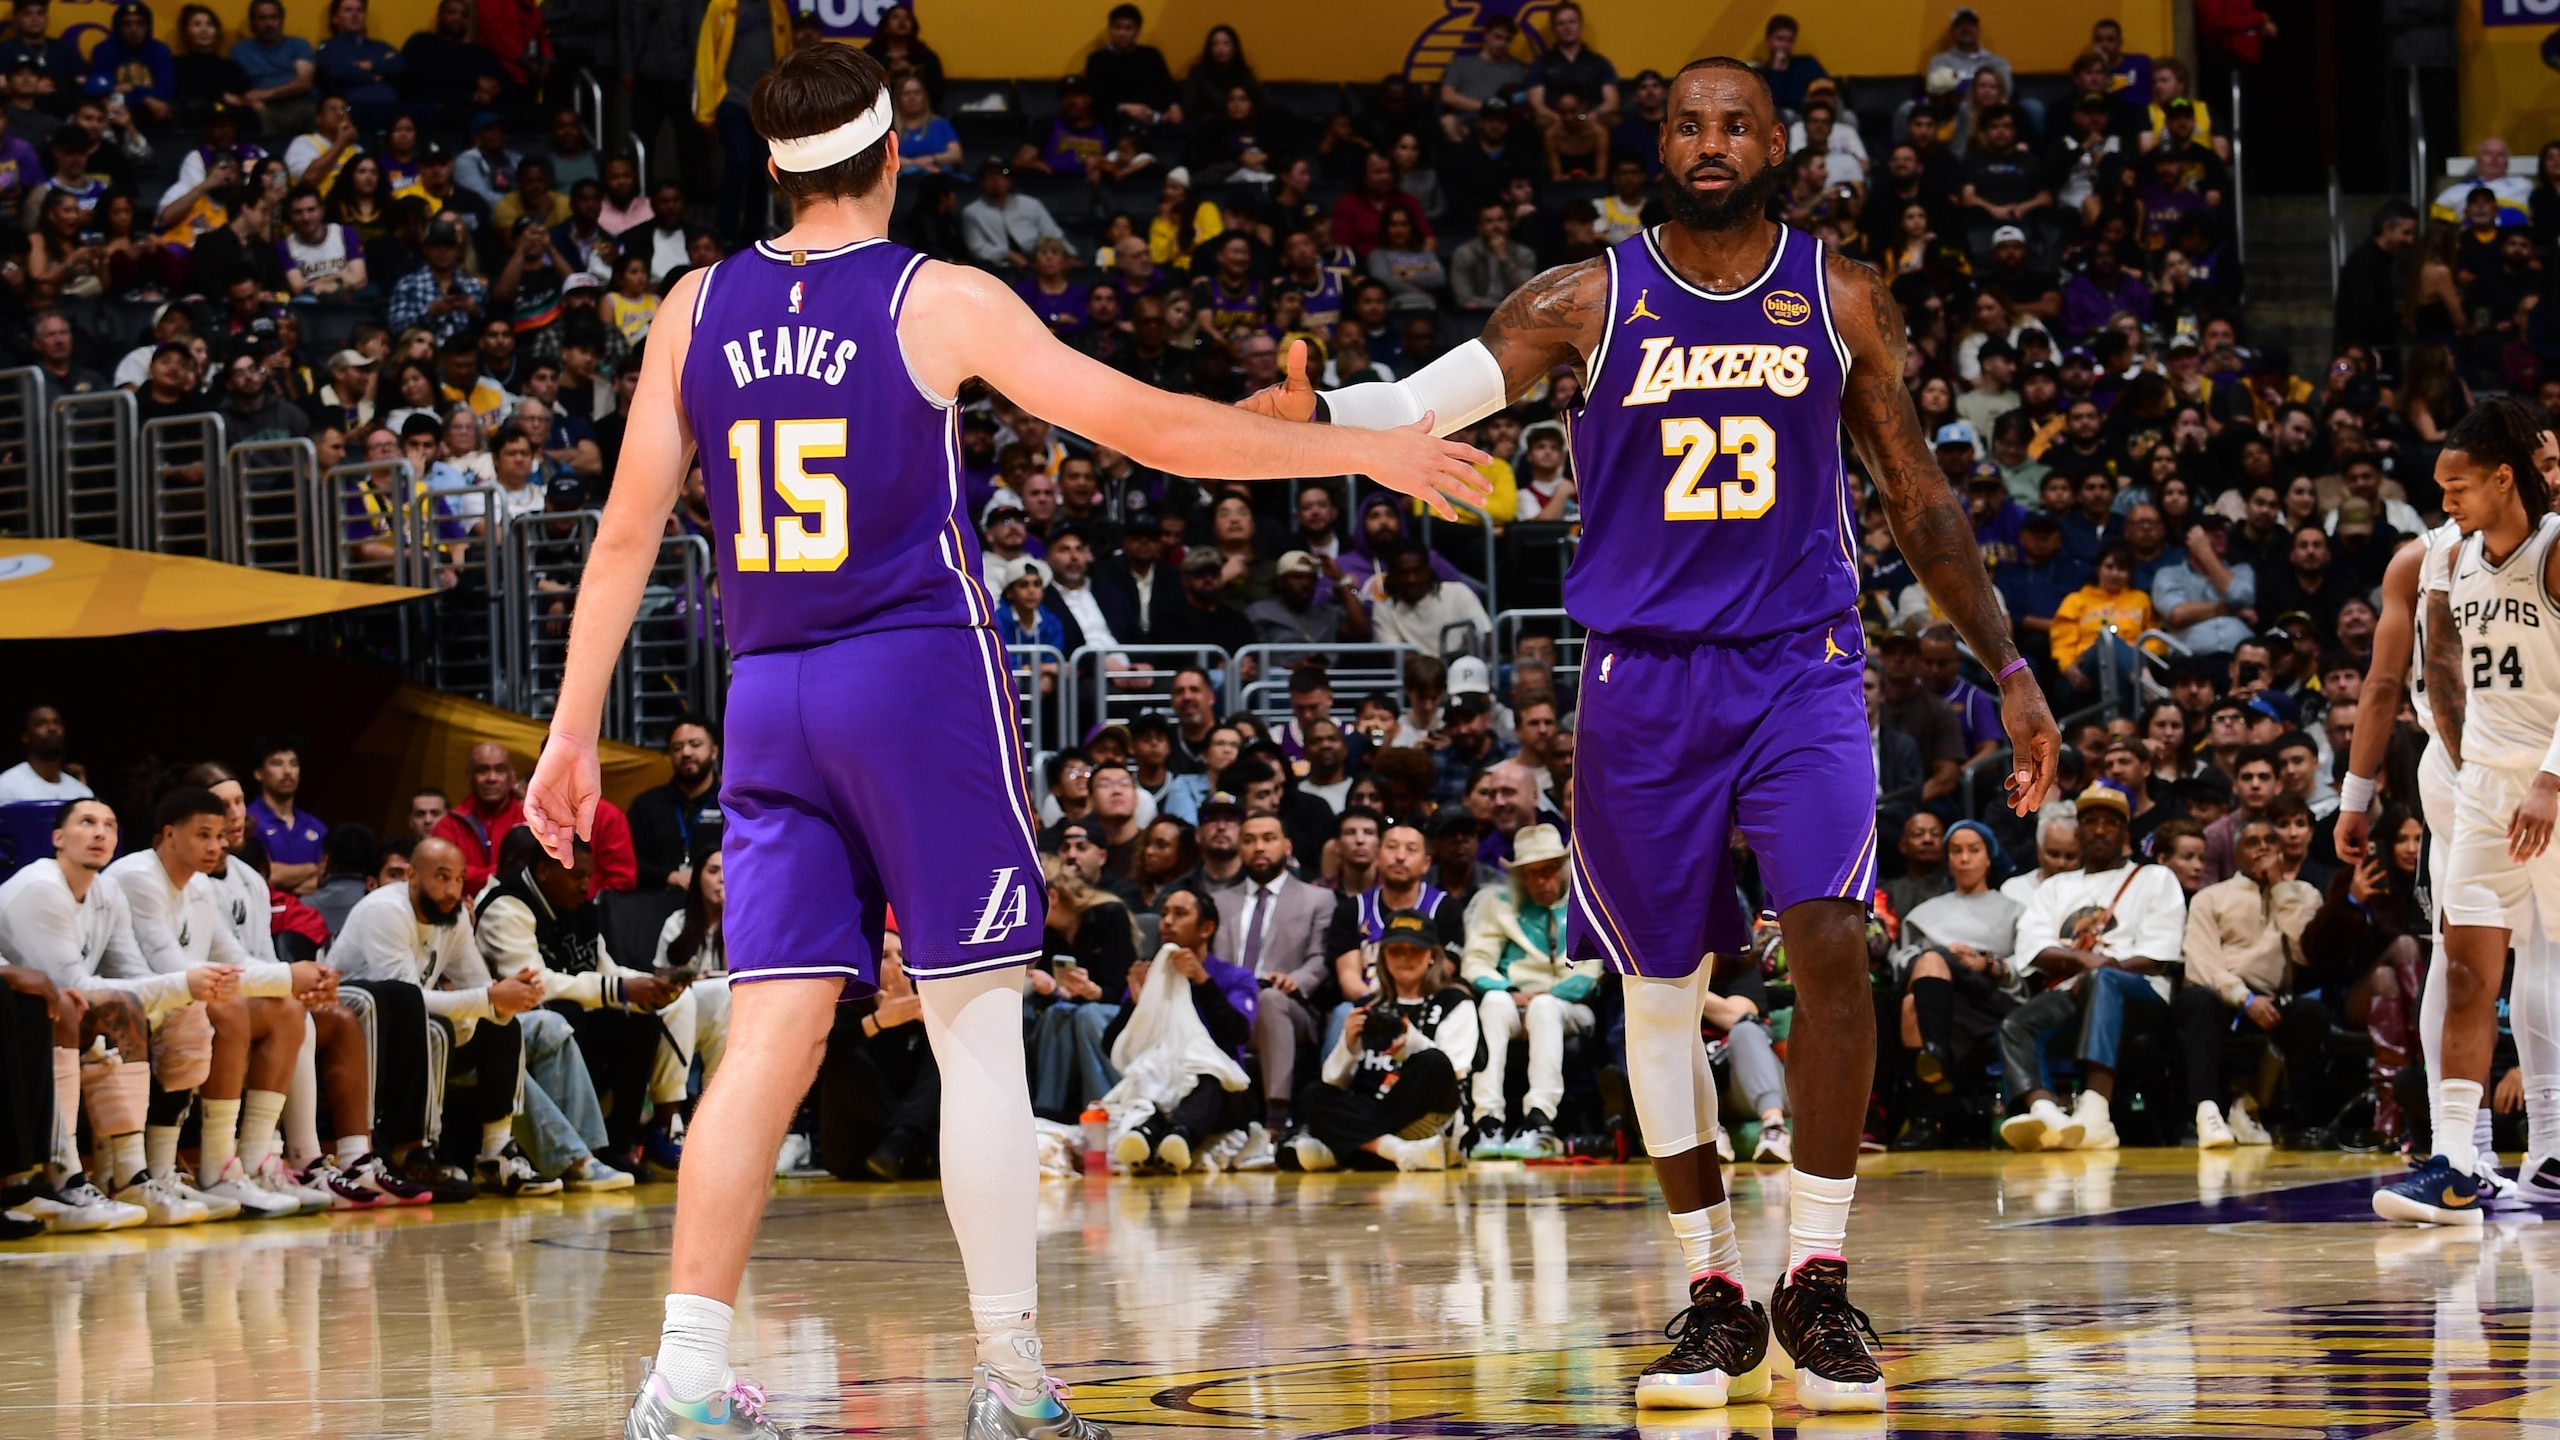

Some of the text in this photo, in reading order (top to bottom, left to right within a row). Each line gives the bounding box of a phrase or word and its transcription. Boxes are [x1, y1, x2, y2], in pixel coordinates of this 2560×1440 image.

[1767, 298, 1808, 318] bibigo
[723, 326, 858, 389] REAVES
[1622, 336, 1810, 407] LAKERS
[728, 418, 849, 572] 15
[1660, 416, 1777, 521] 23
[2452, 598, 2540, 634] SPURS
[2471, 646, 2523, 689] 24
[958, 866, 1028, 945] LA
